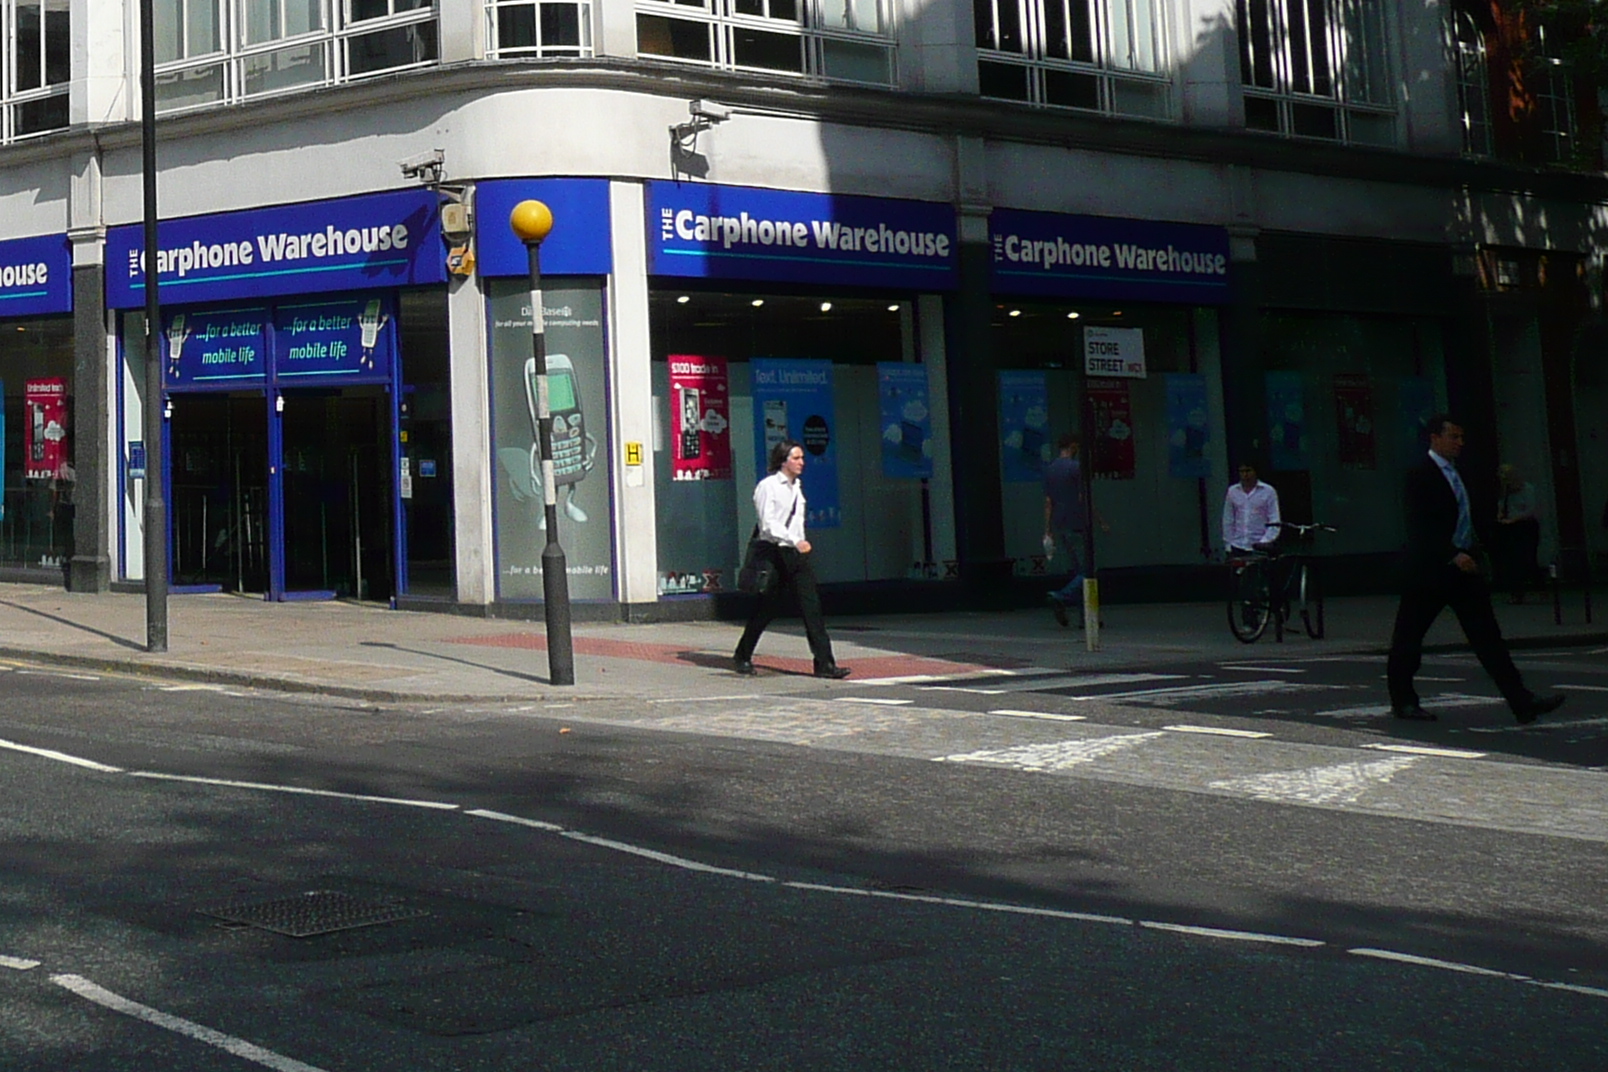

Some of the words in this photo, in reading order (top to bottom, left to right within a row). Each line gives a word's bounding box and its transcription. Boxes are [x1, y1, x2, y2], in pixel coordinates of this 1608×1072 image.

[662, 207, 673, 240] THE
[675, 209, 808, 248] Carphone
[812, 220, 950, 257] Warehouse
[129, 249, 138, 277] THE
[257, 224, 408, 262] Warehouse
[994, 233, 1003, 262] THE
[1005, 235, 1111, 269] Carphone
[1114, 243, 1226, 274] Warehouse
[222, 326, 229, 337] a
[230, 321, 261, 338] better
[309, 320, 316, 331] a
[318, 315, 352, 331] better
[202, 346, 236, 364] mobile
[238, 346, 255, 365] life
[289, 342, 327, 360] mobile
[329, 341, 347, 361] life
[1088, 342, 1120, 356] STORE
[1088, 358, 1124, 372] STREET
[627, 444, 639, 462] H
